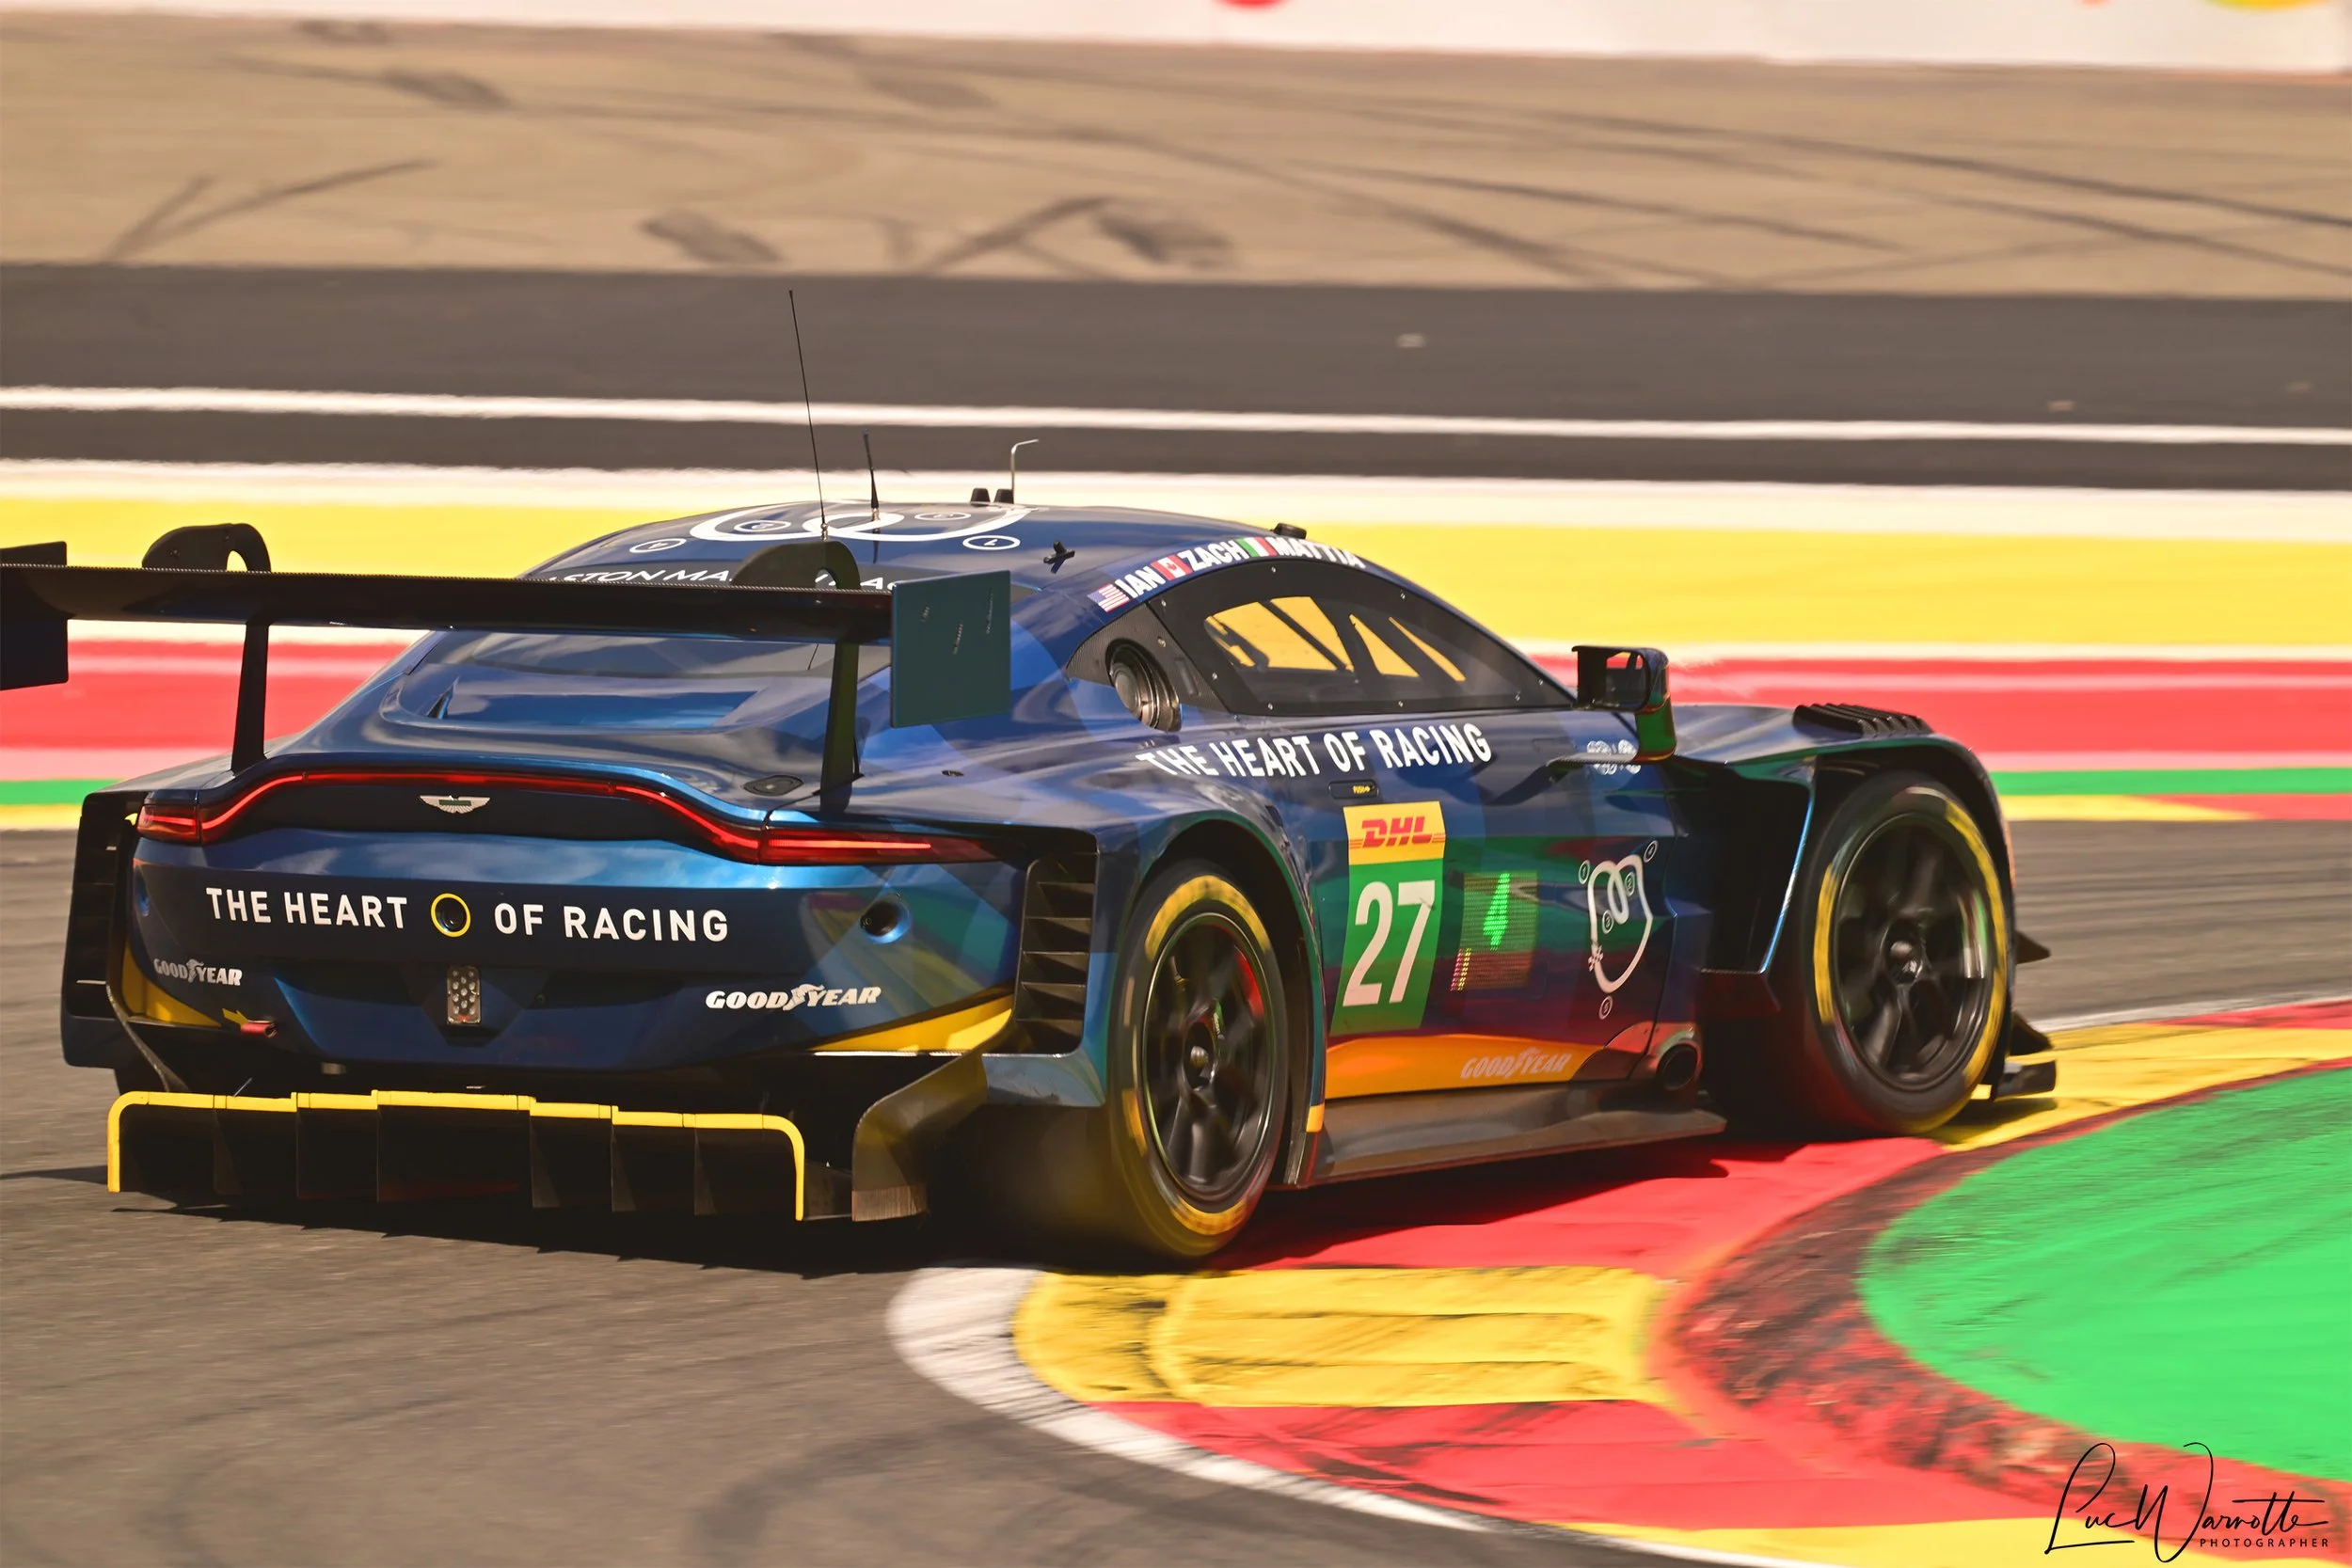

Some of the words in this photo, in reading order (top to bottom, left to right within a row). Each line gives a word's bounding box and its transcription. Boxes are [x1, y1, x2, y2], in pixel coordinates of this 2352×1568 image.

[549, 569, 666, 582] STON
[1115, 566, 1166, 599] IAN
[1180, 539, 1250, 572] ZACH
[1265, 535, 1366, 568] MATTIA
[1135, 745, 1220, 777] THE
[1208, 735, 1320, 778] HEART
[1323, 731, 1366, 773] OF
[1369, 722, 1492, 768] RACING
[1360, 816, 1436, 847] DHL
[205, 887, 272, 923] THE
[283, 891, 408, 929] HEART
[494, 902, 544, 935] OF
[564, 905, 728, 942] RACING
[1342, 879, 1436, 1007] 27
[153, 958, 243, 987] GOODYEAR
[705, 983, 882, 1011] GOODYEAR
[1459, 1047, 1573, 1080] GOODYEAR
